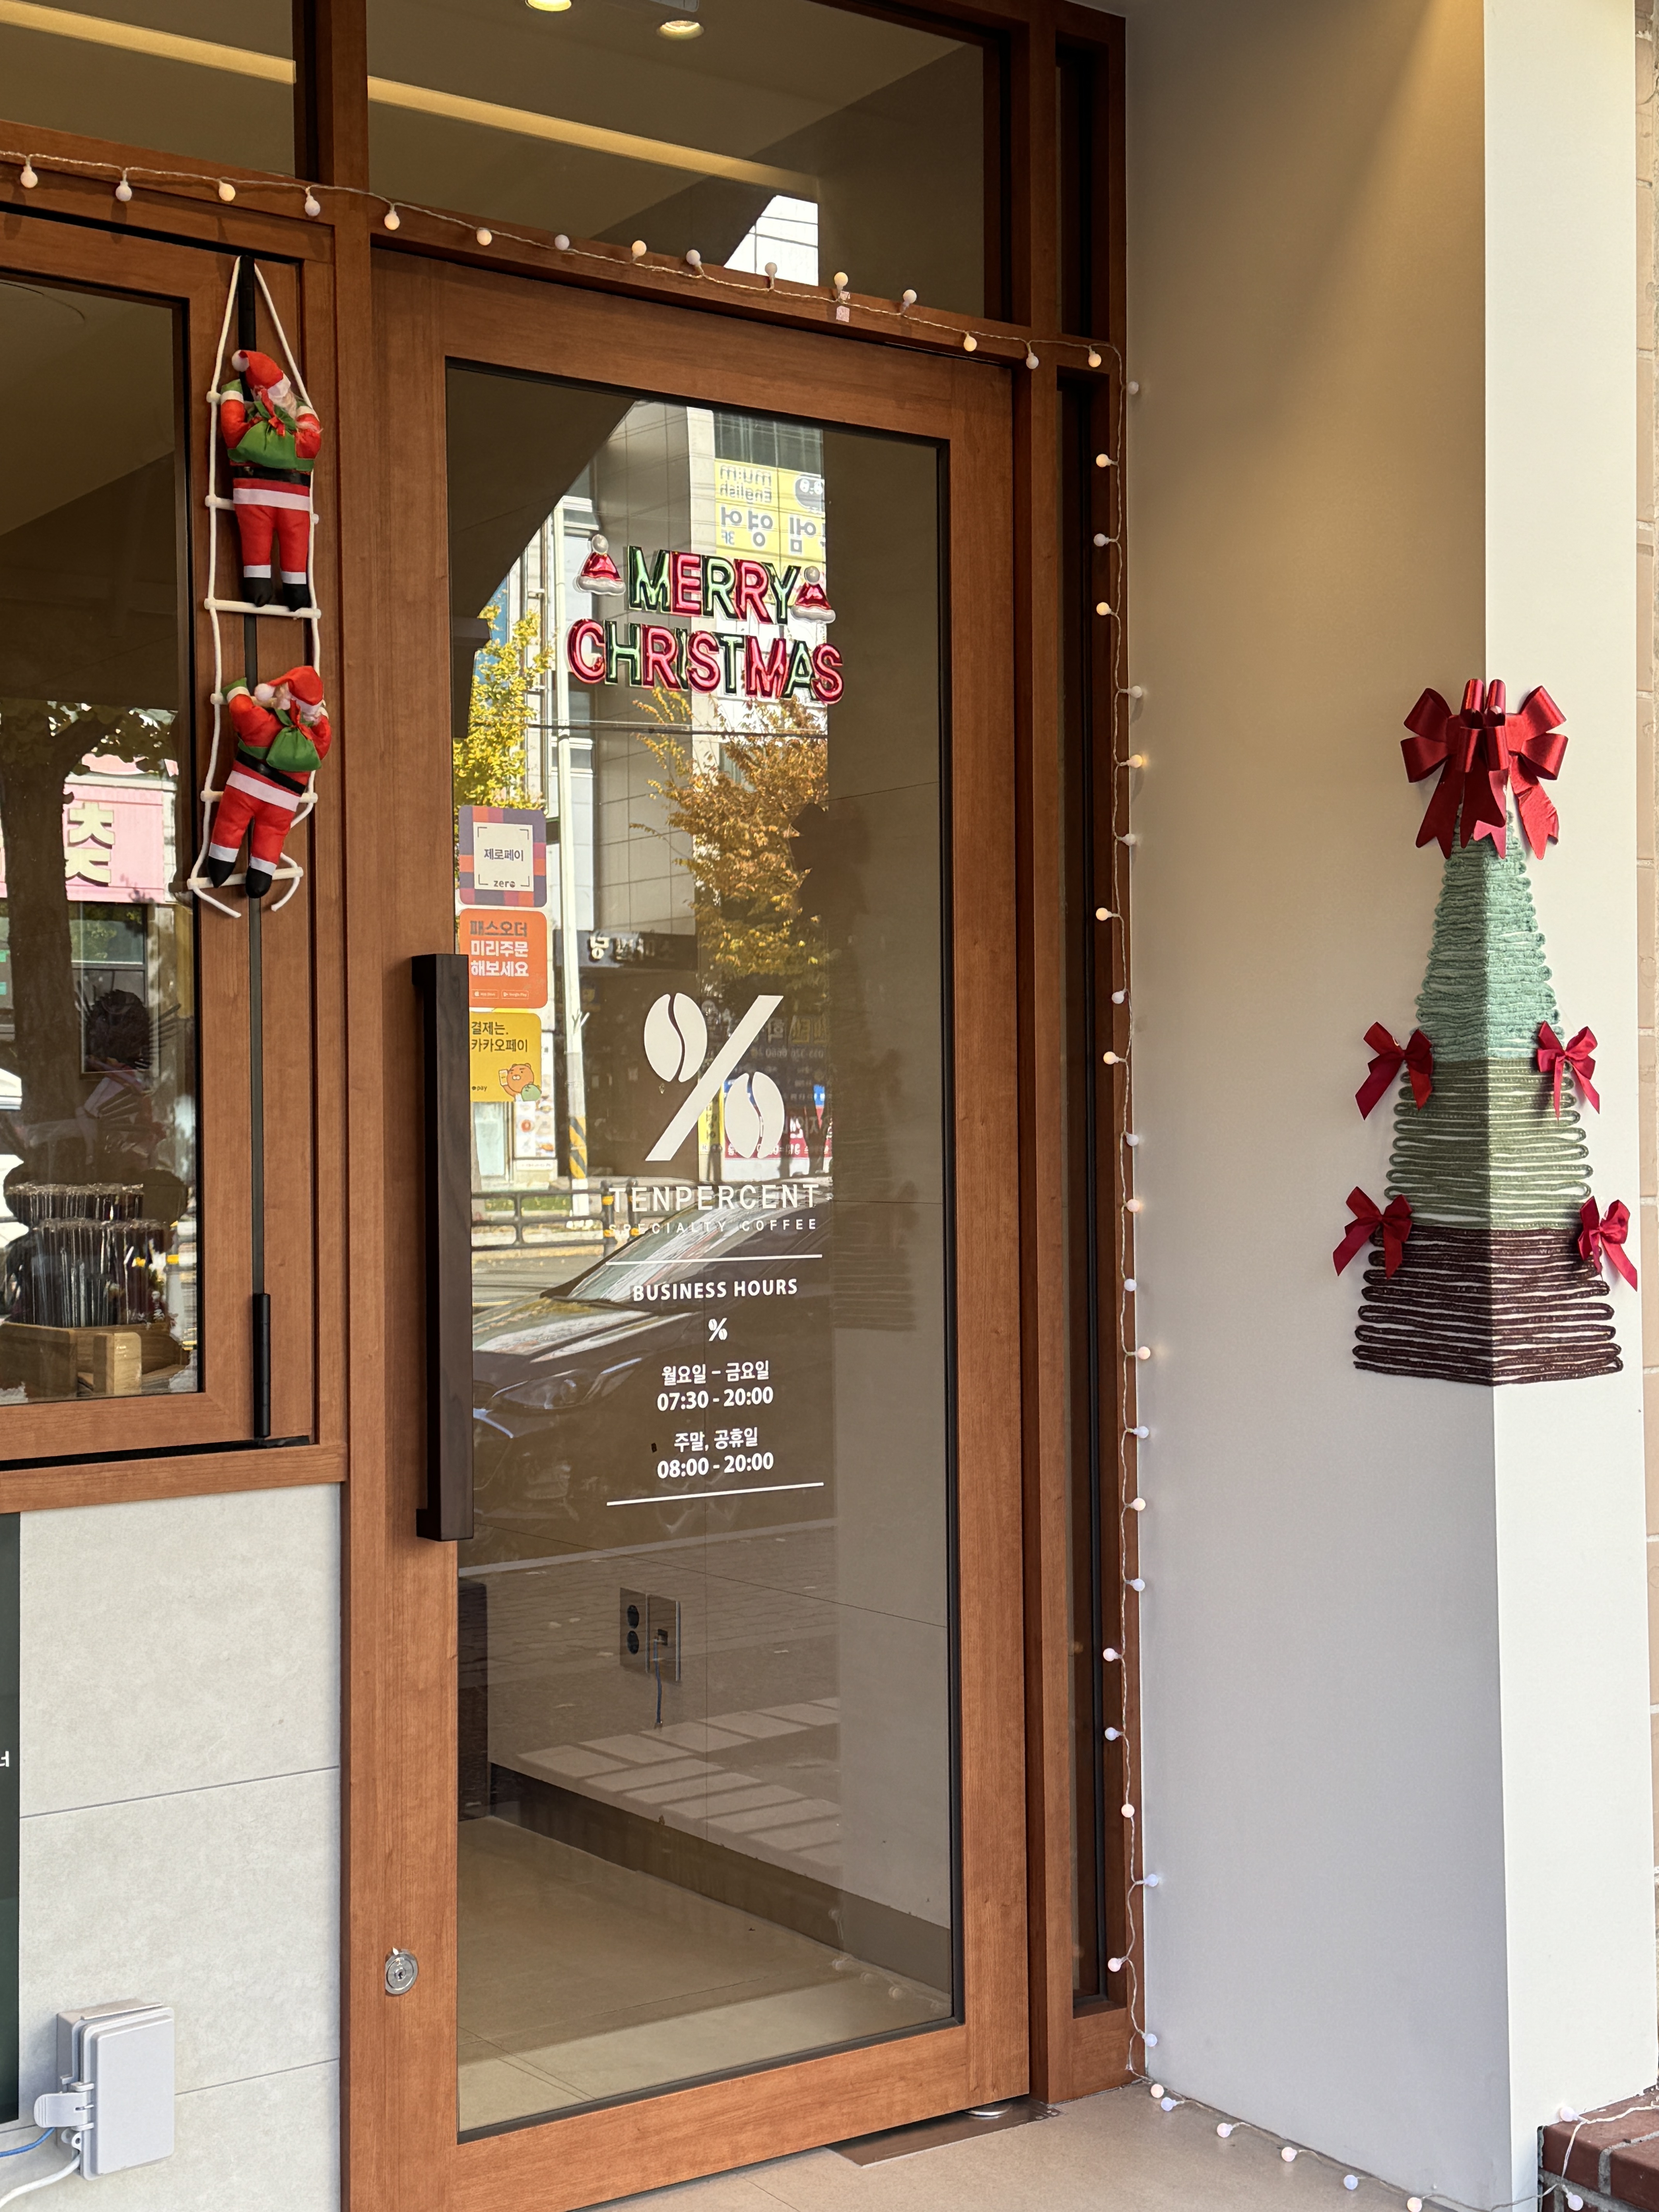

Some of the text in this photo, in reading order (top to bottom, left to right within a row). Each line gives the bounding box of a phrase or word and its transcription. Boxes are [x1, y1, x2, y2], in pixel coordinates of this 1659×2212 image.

[628, 545, 801, 625] MERRY
[567, 618, 845, 705] CHRISTMAS
[484, 848, 524, 861] 제로페이
[470, 920, 527, 937] 패스오더
[471, 940, 529, 958] 미리주문
[471, 960, 529, 977] 해보세요
[471, 1039, 527, 1053] 카카오페이
[608, 1184, 819, 1212] TENPERCENT
[742, 1218, 816, 1232] COFFEE
[633, 1278, 798, 1301] BUSINESS HOURS
[662, 1364, 706, 1386] 월요일
[725, 1360, 769, 1382] 금요일
[657, 1390, 709, 1411] 07:30
[723, 1386, 774, 1407] 20:00
[714, 1427, 758, 1449] 공휴일
[657, 1457, 709, 1479] 08:00
[724, 1452, 774, 1473] 20:00
